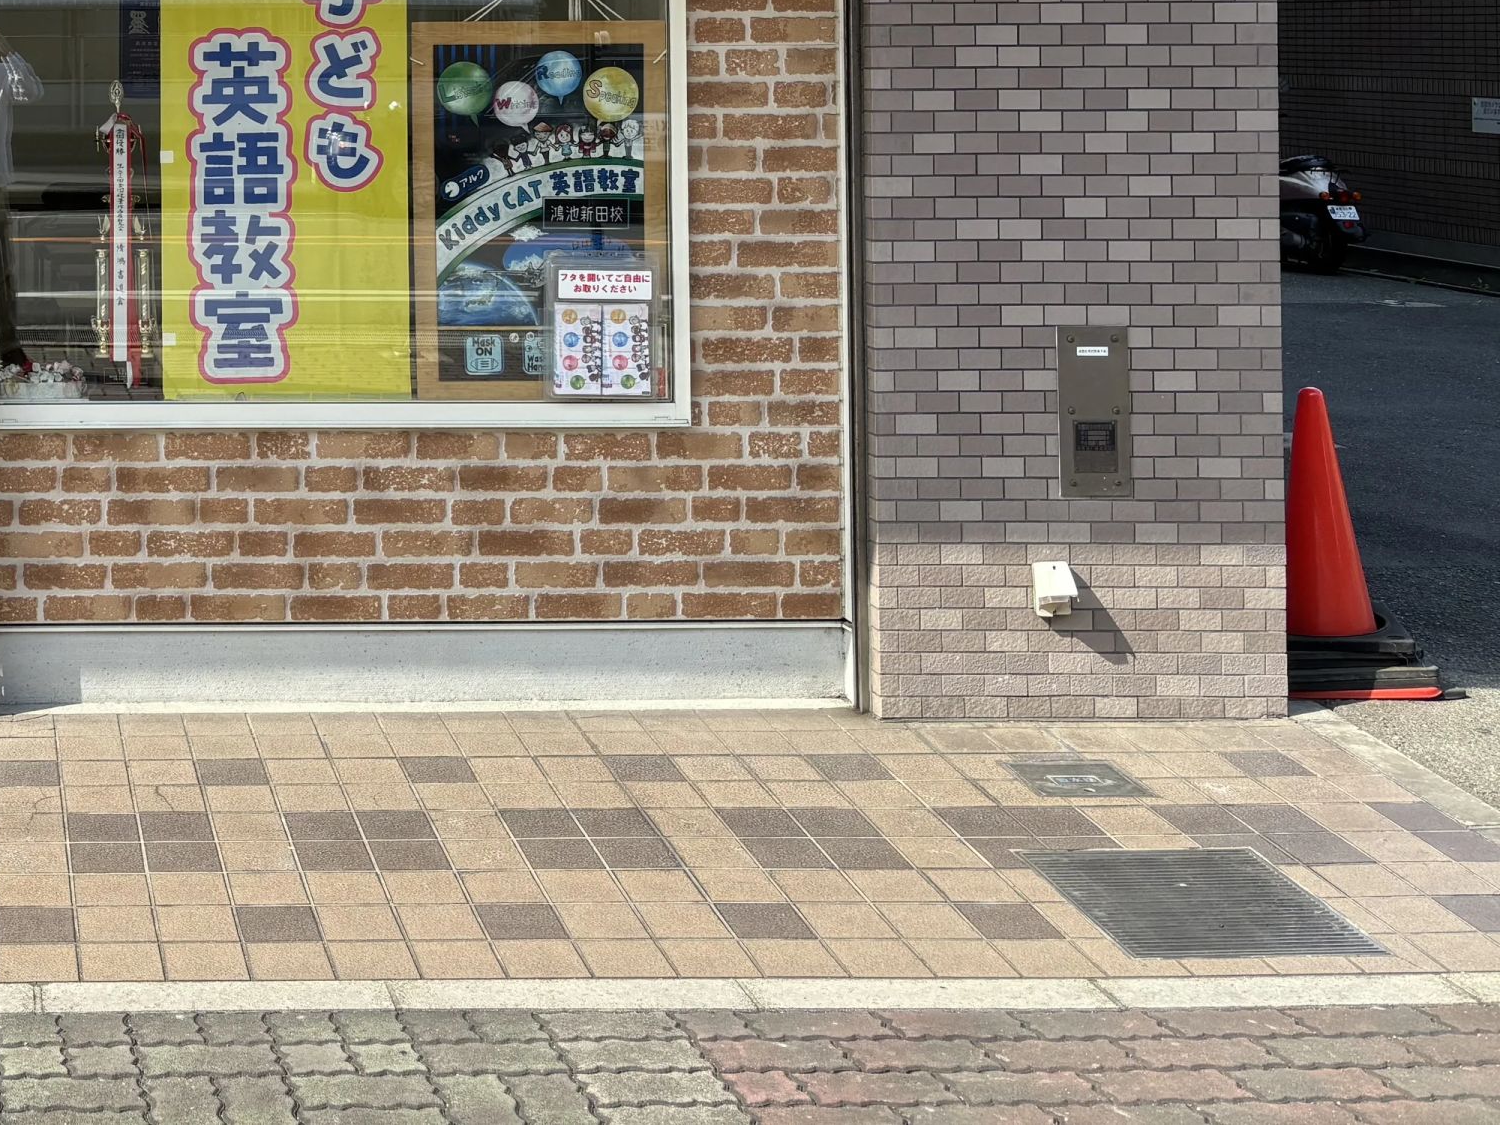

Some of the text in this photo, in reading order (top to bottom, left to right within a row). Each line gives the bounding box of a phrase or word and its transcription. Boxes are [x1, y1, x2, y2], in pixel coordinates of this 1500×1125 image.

[199, 40, 284, 370] 英語教室
[439, 168, 640, 251] Kiddy CAT 英語教室
[550, 205, 624, 223] 鴻池新田校
[560, 272, 651, 283] フタを開いてご自由に
[573, 283, 638, 294] お取りください
[472, 336, 496, 347] Mask
[476, 348, 493, 356] ON
